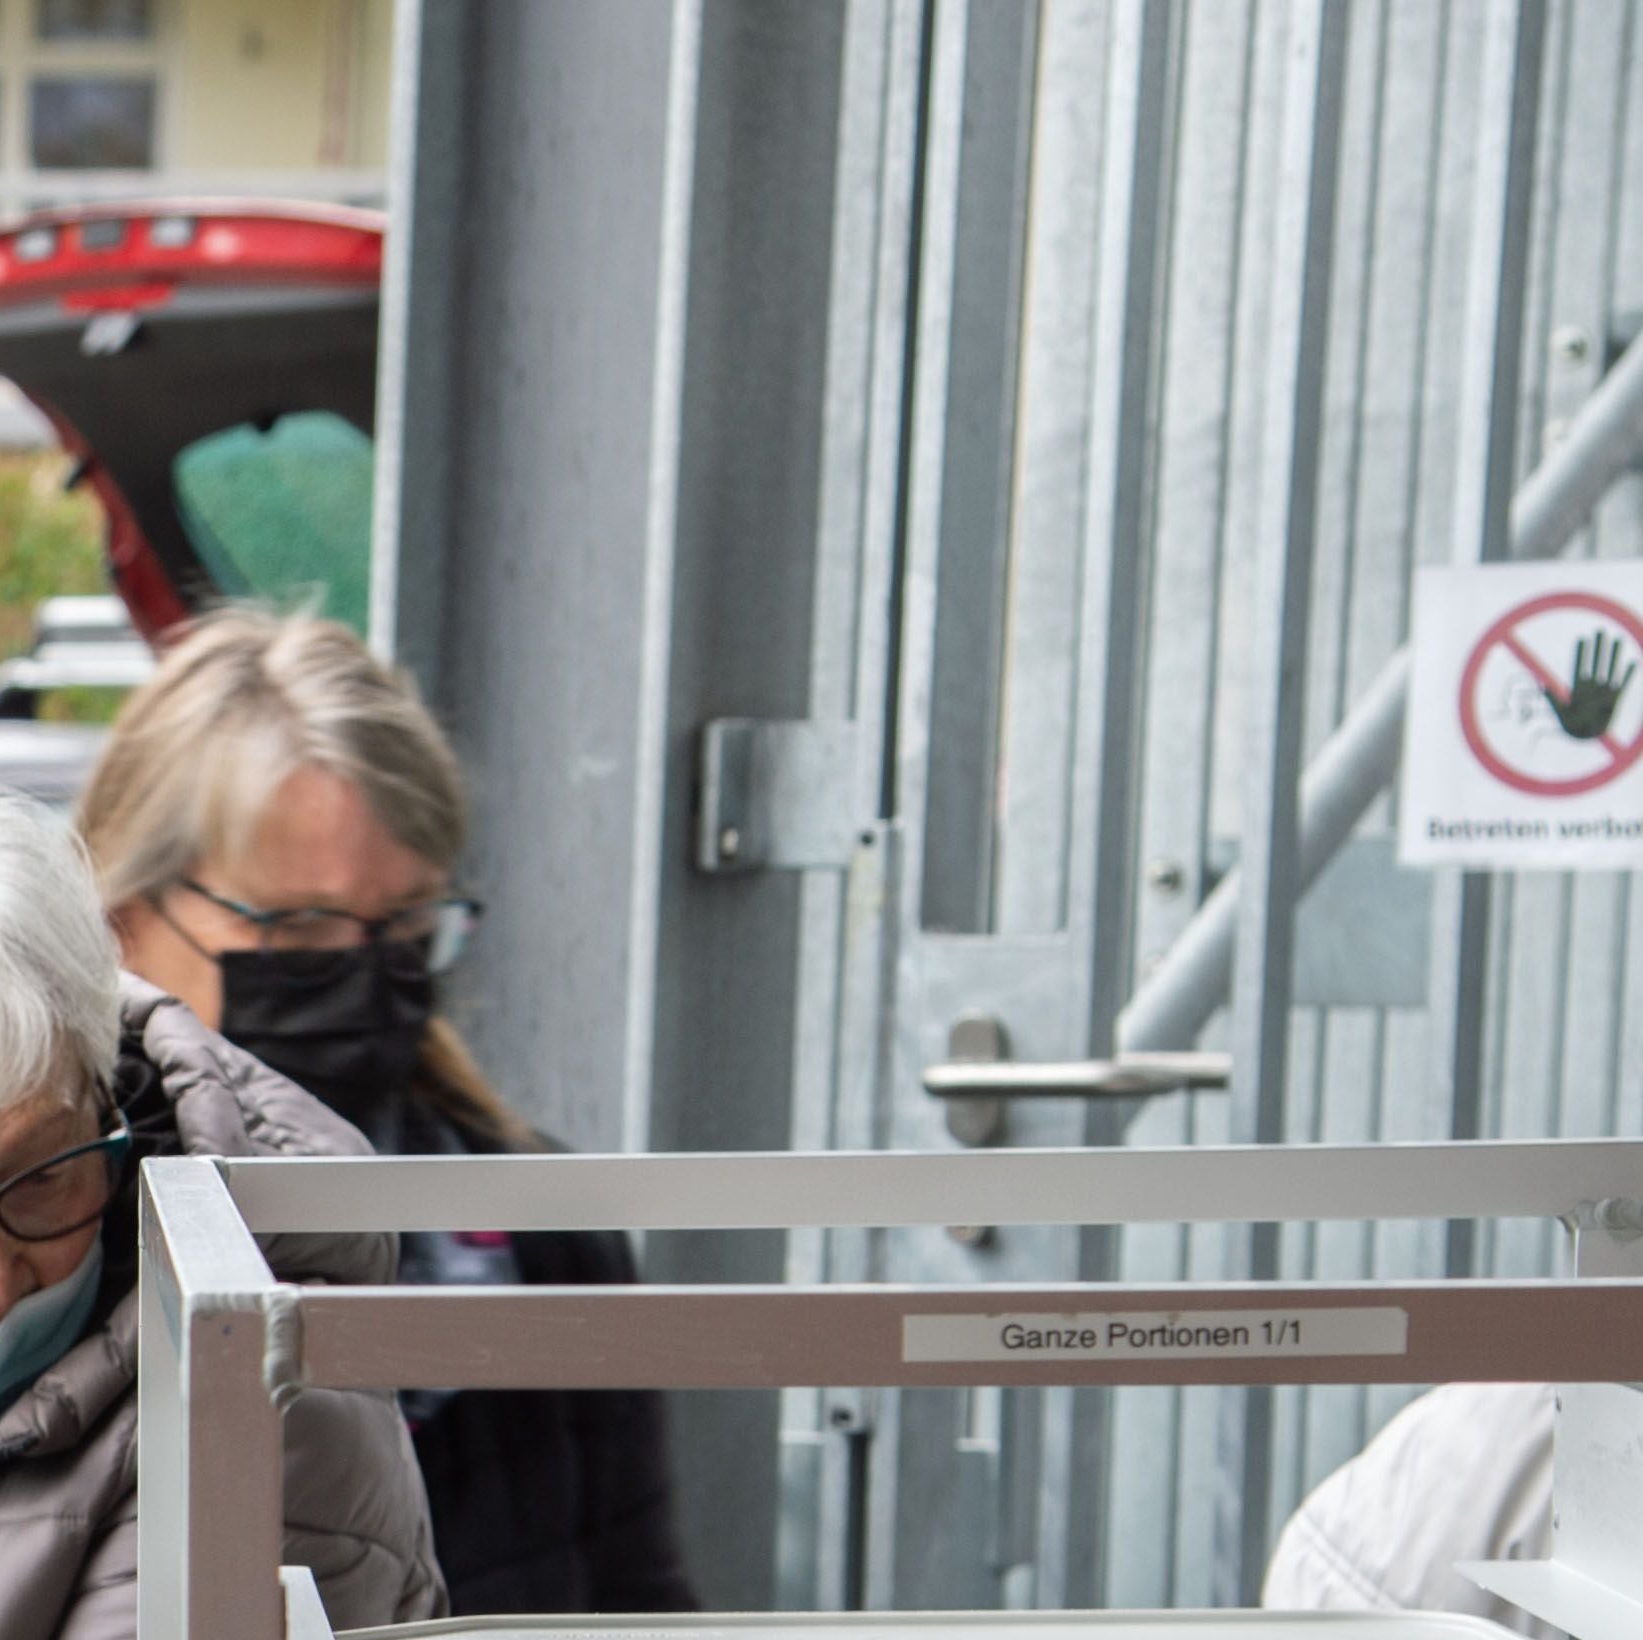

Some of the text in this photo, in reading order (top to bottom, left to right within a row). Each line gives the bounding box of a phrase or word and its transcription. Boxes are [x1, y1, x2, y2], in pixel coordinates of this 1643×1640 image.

[1428, 813, 1643, 839] Betreten verbo
[1001, 1320, 1302, 1350] Ganze Portionen 1/1
